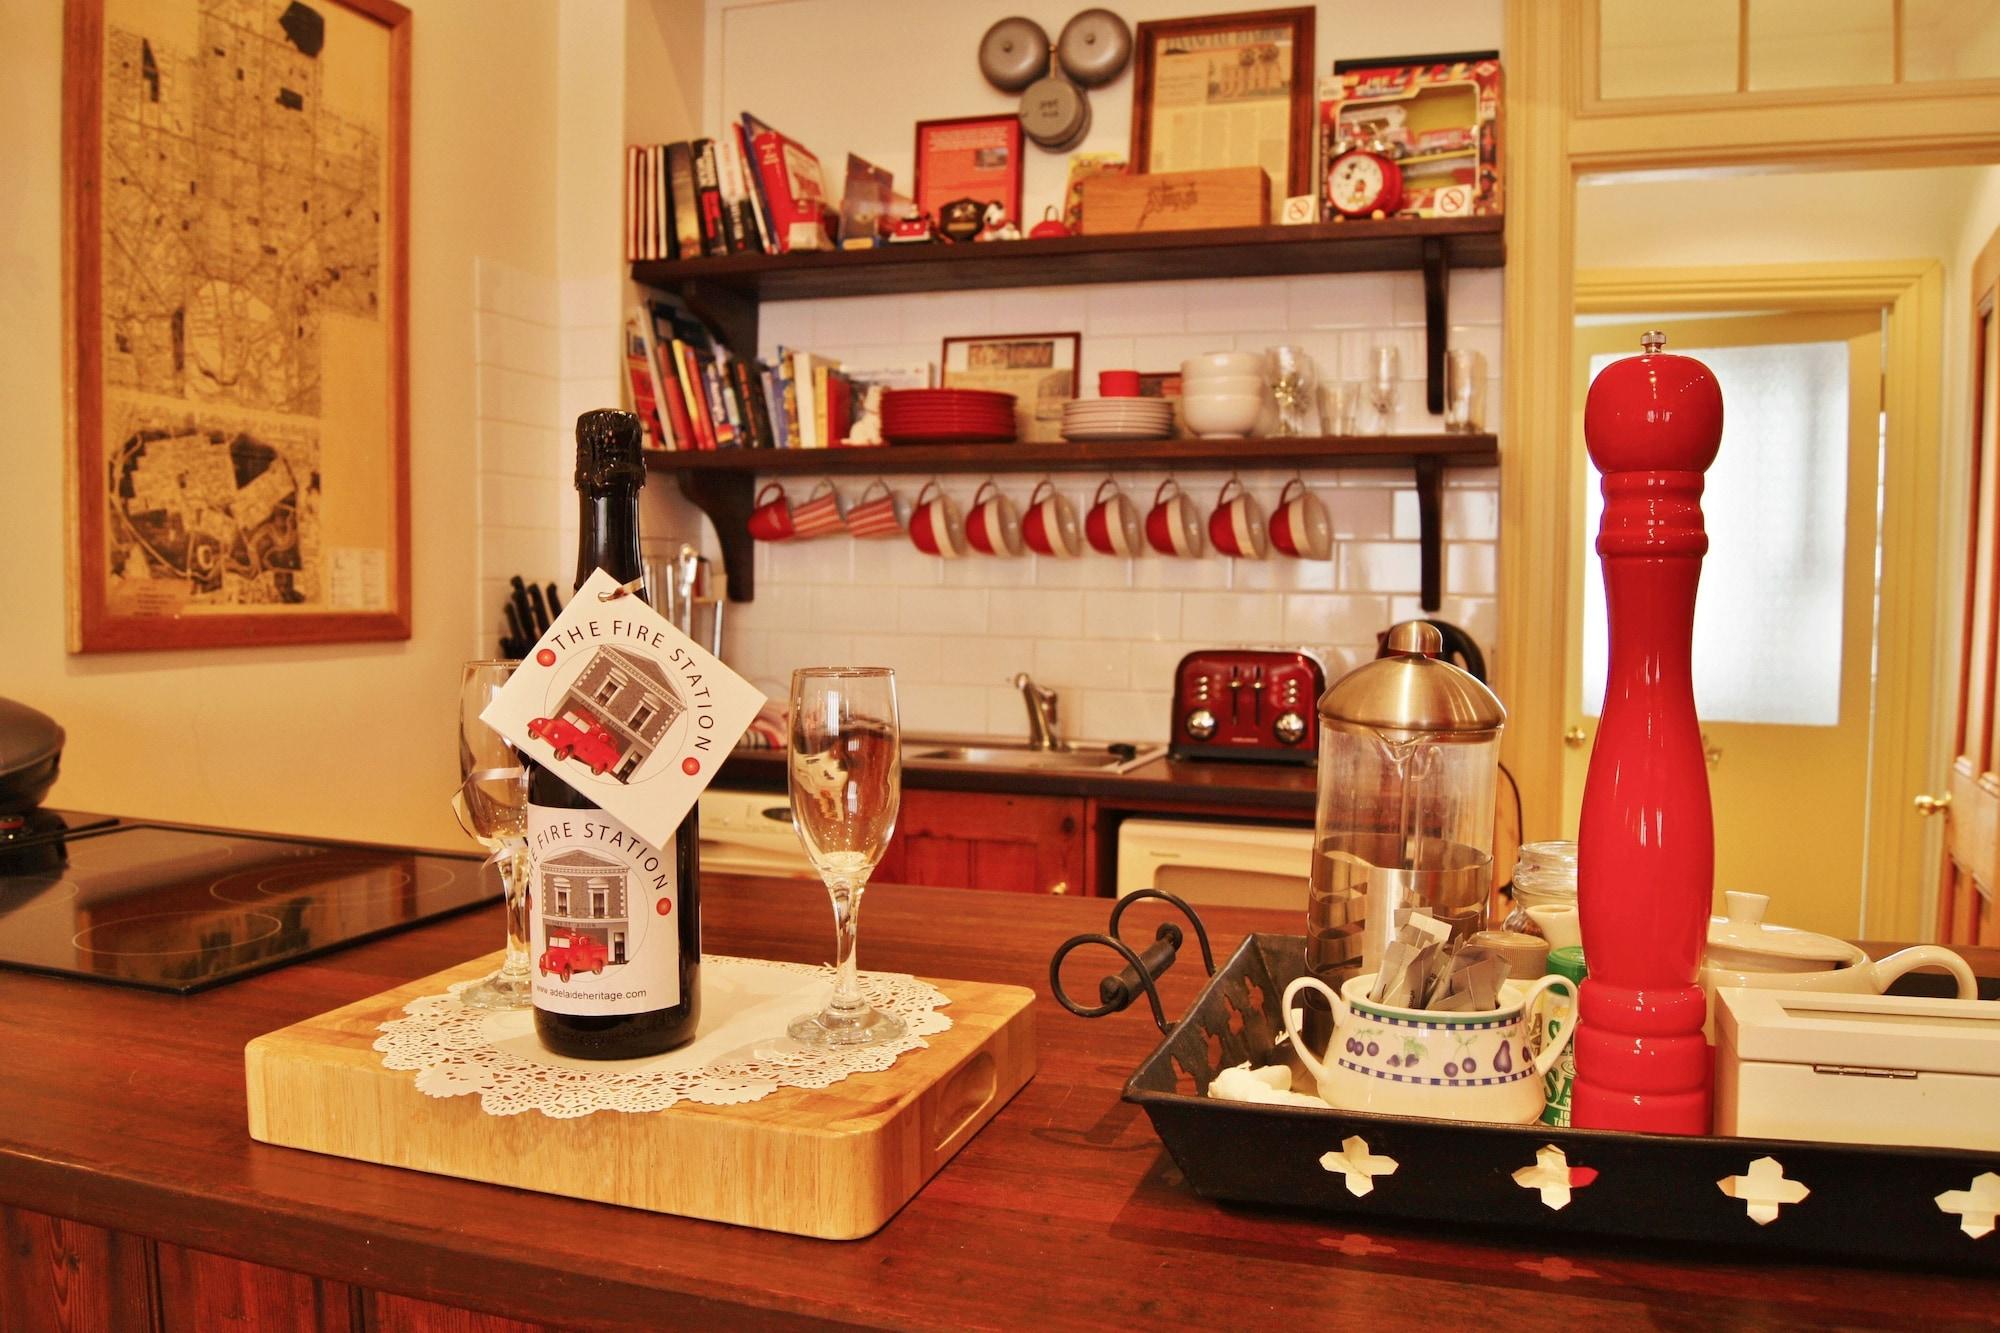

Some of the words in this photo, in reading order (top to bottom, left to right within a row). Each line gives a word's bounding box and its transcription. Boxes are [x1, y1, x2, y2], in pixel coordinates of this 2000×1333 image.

[551, 621, 601, 650] THE
[613, 620, 665, 648] FIRE
[669, 648, 714, 751] STATION
[537, 822, 572, 849] FIRE
[584, 822, 668, 890] STATION
